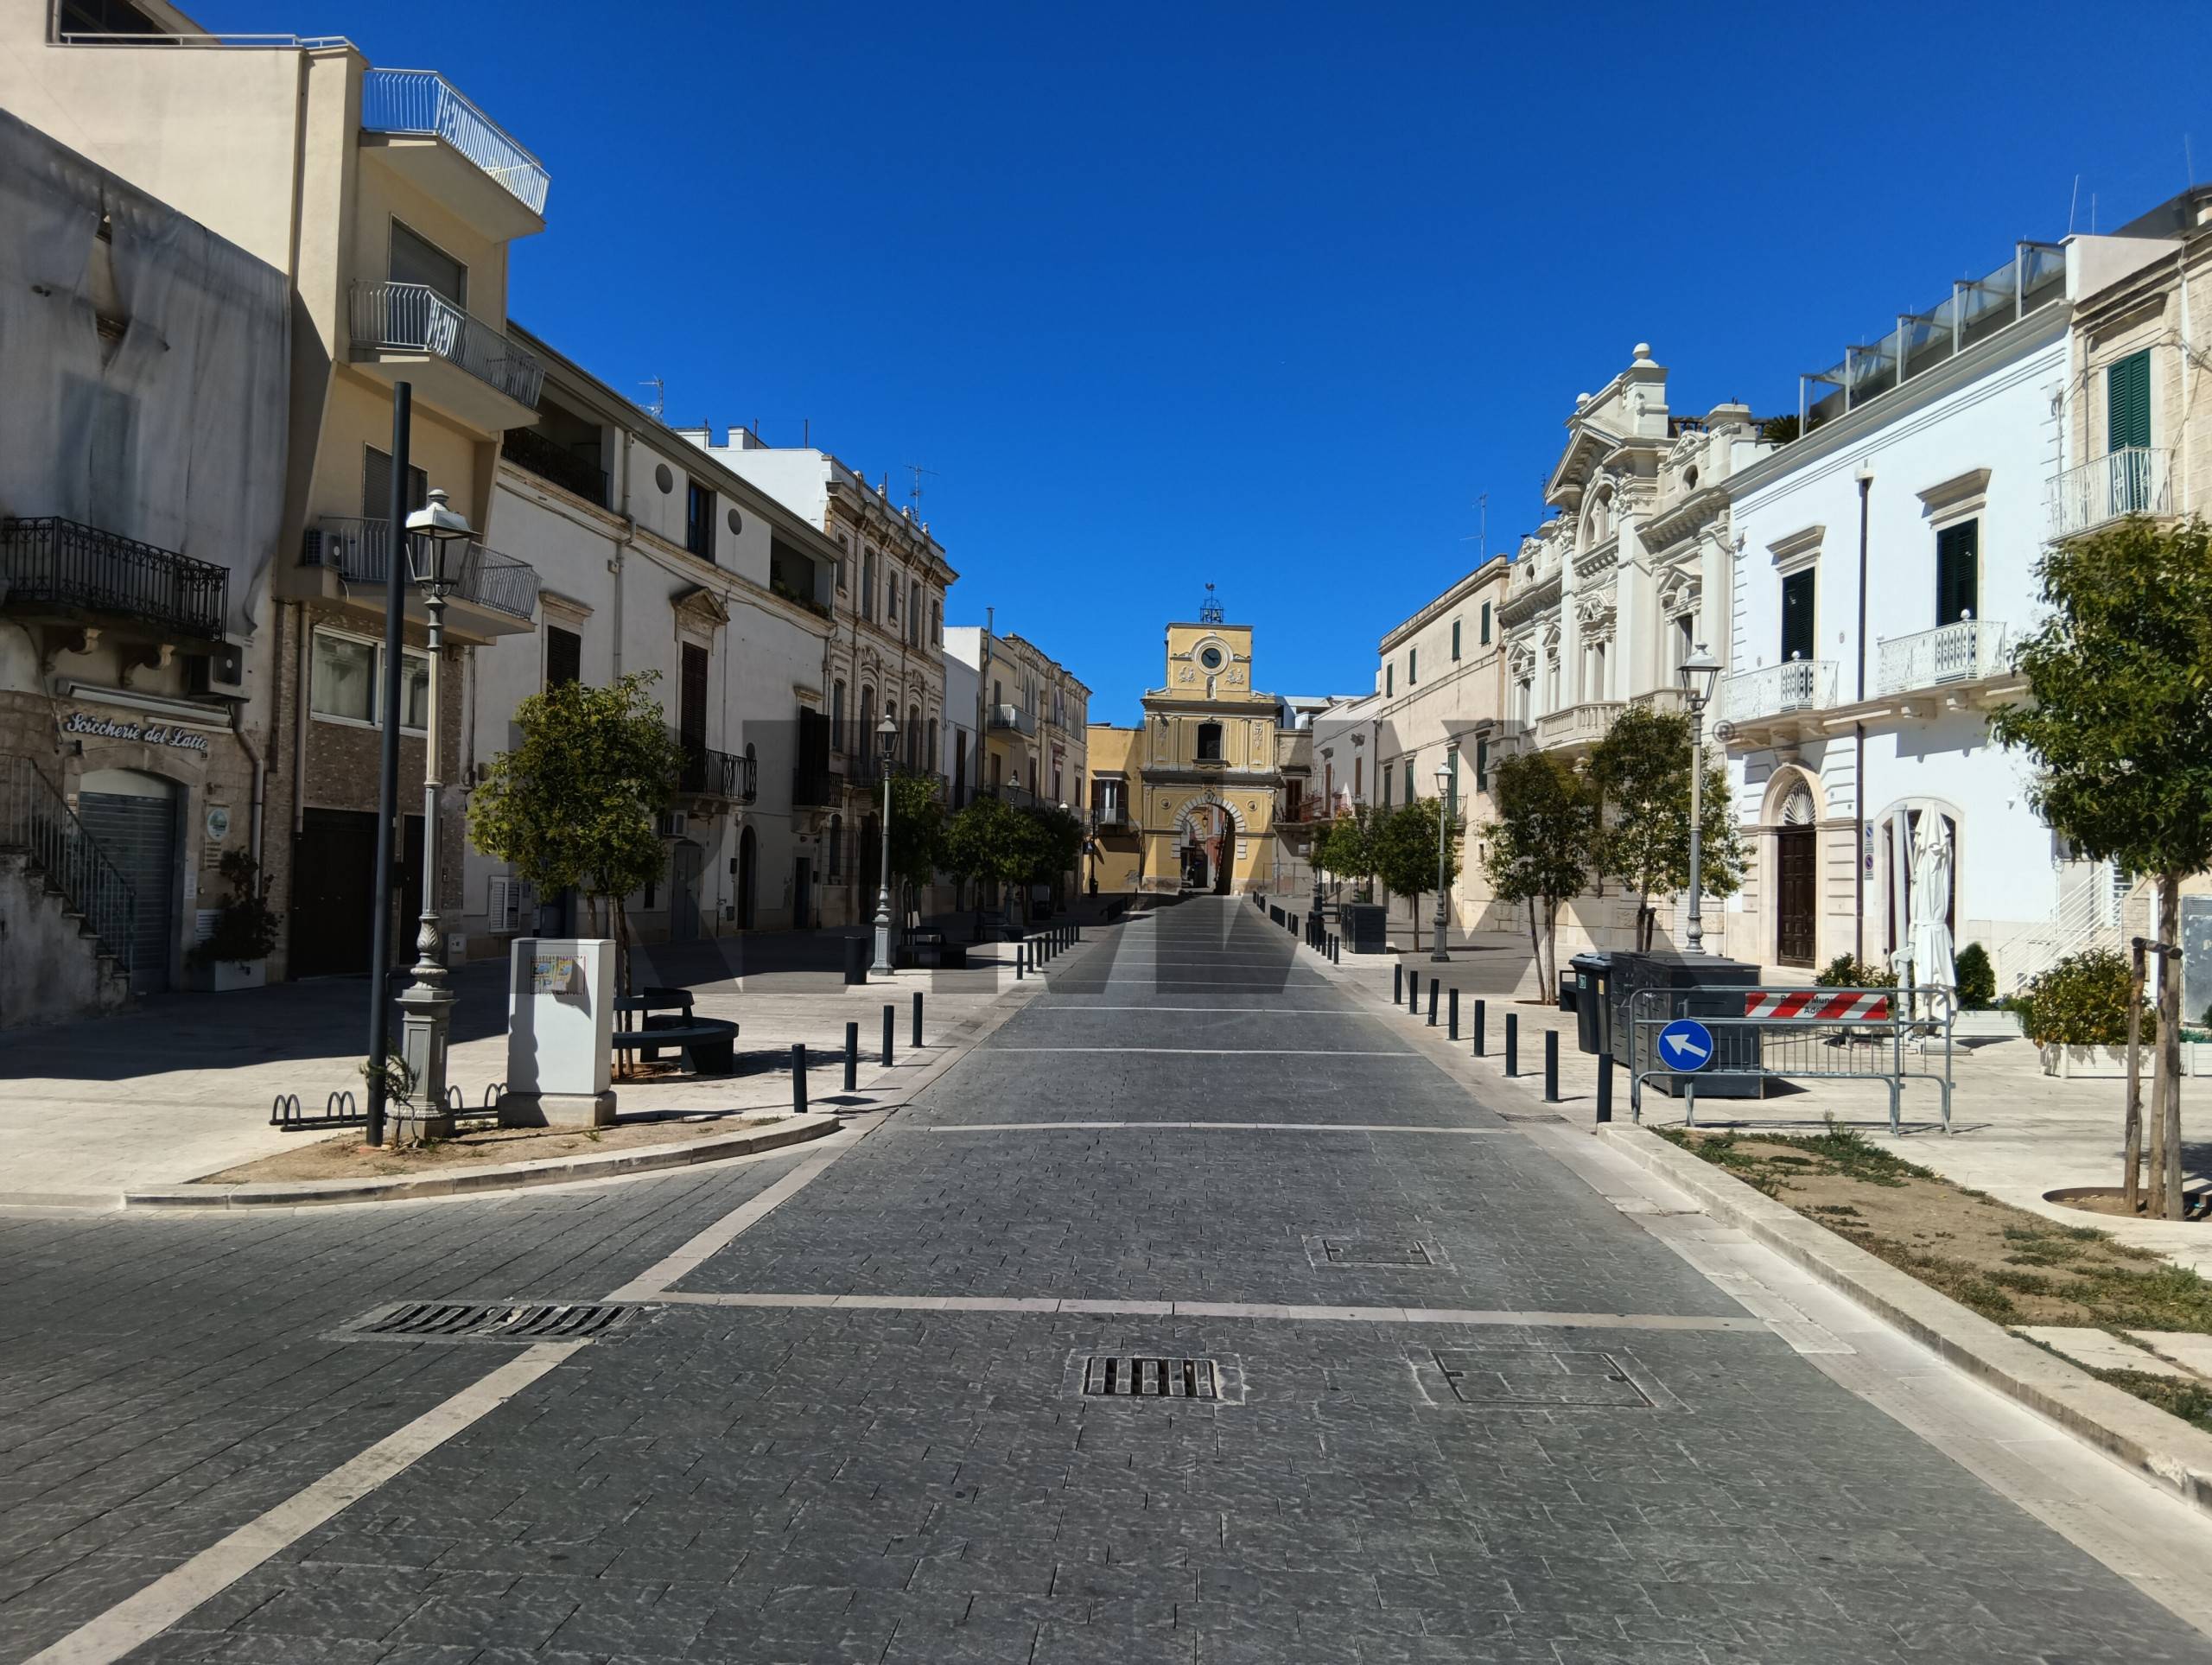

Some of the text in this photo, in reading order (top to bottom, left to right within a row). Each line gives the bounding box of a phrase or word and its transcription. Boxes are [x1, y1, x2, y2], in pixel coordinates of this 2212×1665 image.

[67, 713, 208, 750] Sciccherie del Latte
